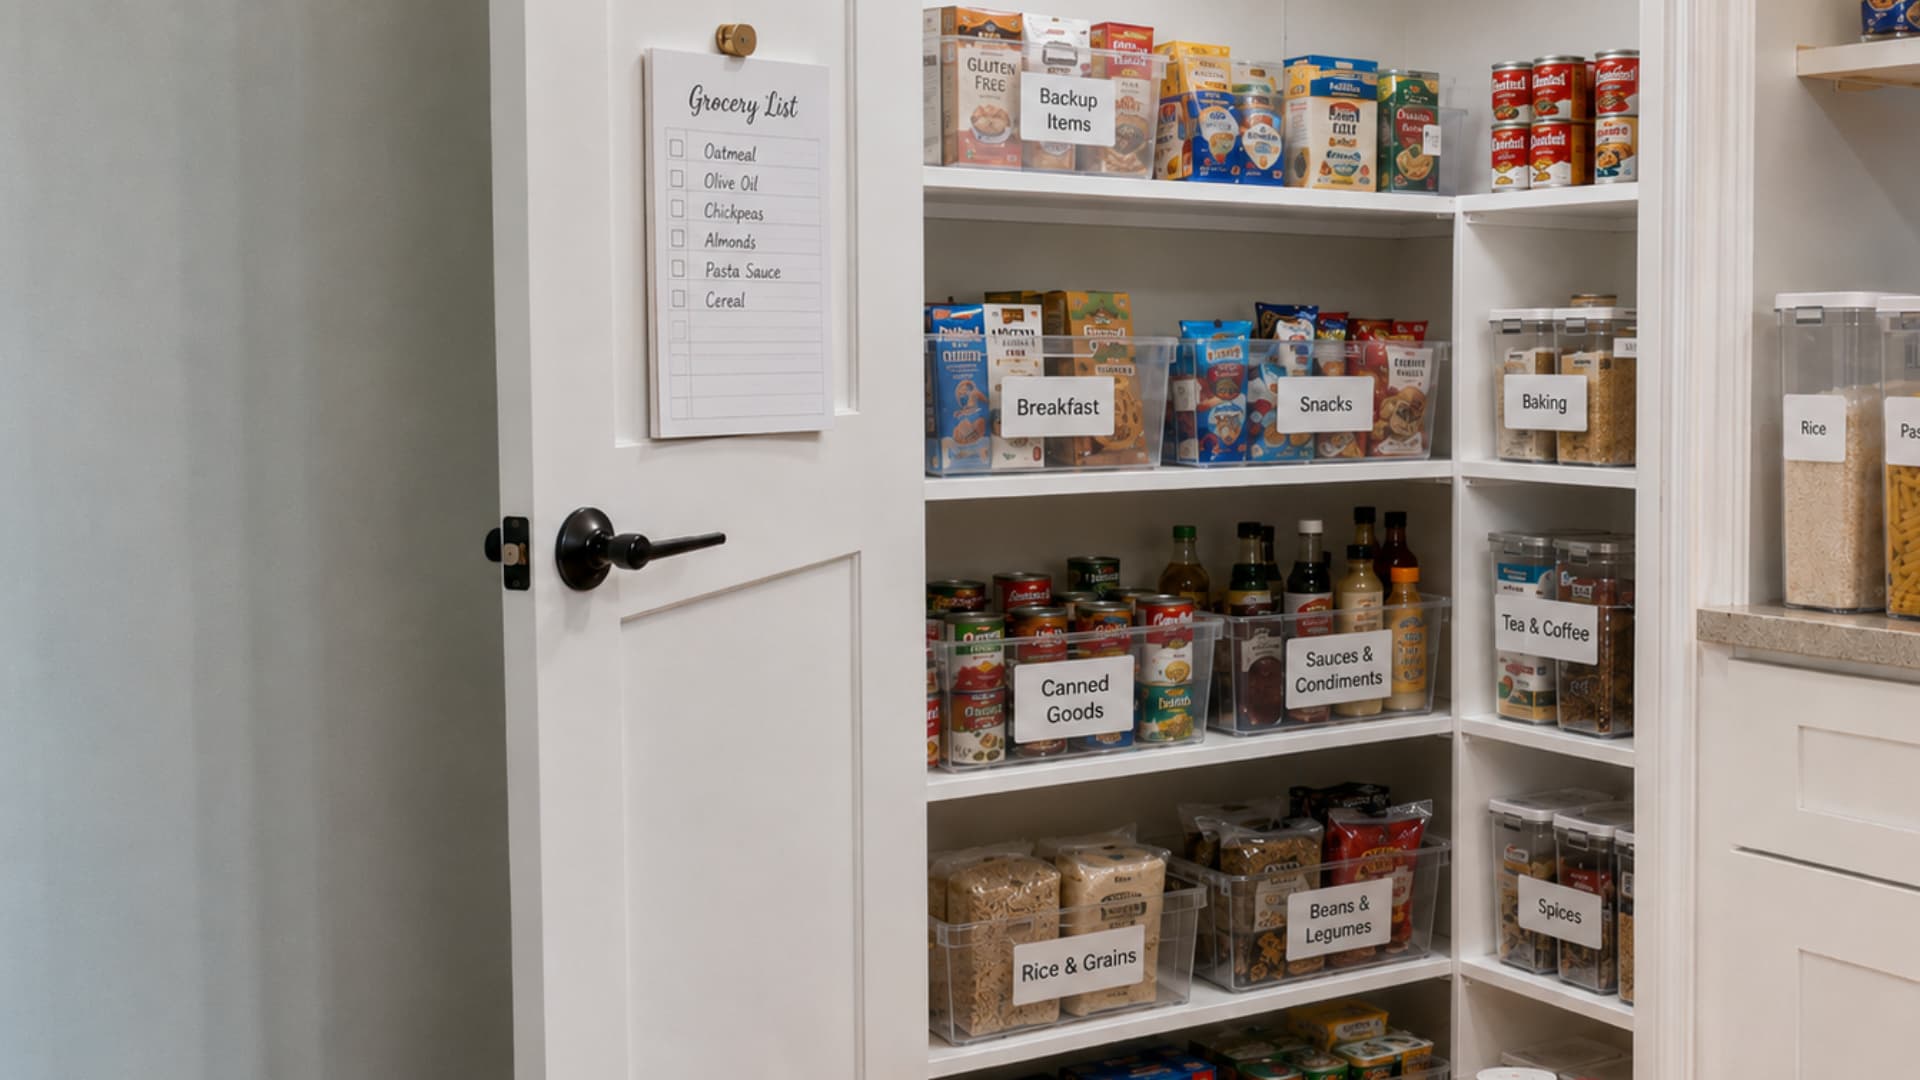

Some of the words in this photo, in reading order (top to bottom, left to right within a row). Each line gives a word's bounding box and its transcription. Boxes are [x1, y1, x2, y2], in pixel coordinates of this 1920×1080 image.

[966, 56, 1017, 75] GLUTEN
[975, 74, 1007, 92] FREE
[688, 84, 760, 126] Grocery
[764, 90, 798, 119] List
[1039, 87, 1098, 113] Backup
[1047, 112, 1092, 133] Items
[703, 142, 757, 163] Oatmeal
[703, 172, 736, 191] Olive
[740, 174, 759, 192] Oil
[703, 201, 764, 223] Chickpeas
[704, 231, 757, 251] Almonds
[705, 261, 741, 279] Pasta
[745, 262, 782, 280] Sauce
[705, 290, 746, 309] Cereal
[1017, 396, 1100, 416] Breakfast
[1299, 394, 1353, 413] Snacks
[1522, 393, 1568, 415] Baking
[1801, 420, 1827, 436] Rice
[1501, 613, 1526, 633] Tea
[1529, 617, 1540, 635] &
[1542, 619, 1590, 643] Coffee
[1306, 650, 1359, 668] Sauces
[1362, 645, 1373, 663] &
[1041, 673, 1110, 698] Canned
[1295, 671, 1383, 694] Condiments
[1046, 701, 1104, 724] Goods
[1310, 901, 1355, 920] Beans
[1358, 894, 1370, 912] &
[1538, 897, 1582, 925] Spices
[1305, 920, 1372, 945] Legumes
[1021, 962, 1060, 983] Rice
[1064, 956, 1078, 975] &
[1082, 948, 1137, 972] Grains
